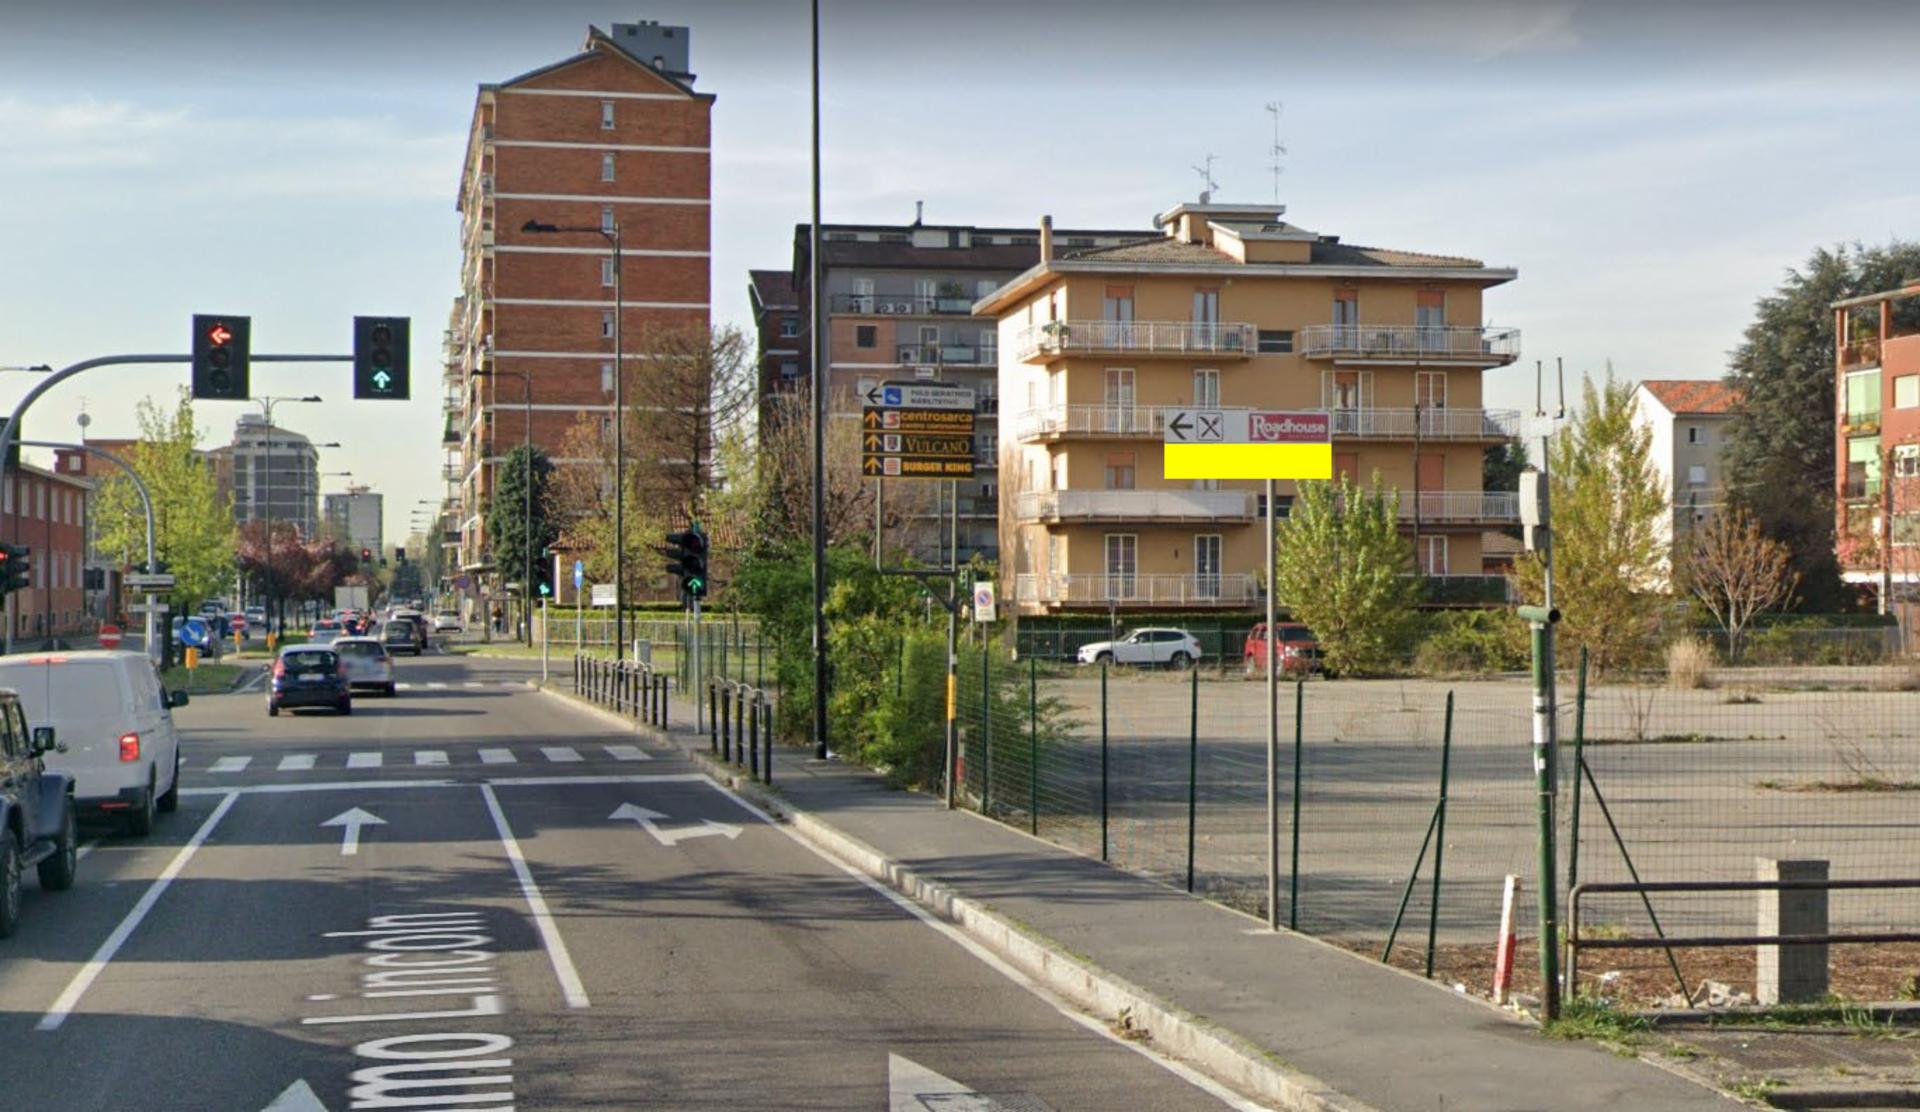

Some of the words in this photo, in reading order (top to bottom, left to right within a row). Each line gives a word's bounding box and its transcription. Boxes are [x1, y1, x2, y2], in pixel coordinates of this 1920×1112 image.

[900, 410, 973, 423] centrosarca
[1252, 415, 1325, 440] Roadhouse
[906, 438, 969, 454] VULCANO
[902, 461, 942, 473] BURGER
[944, 462, 973, 473] KING
[300, 911, 503, 1025] Lincoln
[348, 1032, 515, 1112] mo
